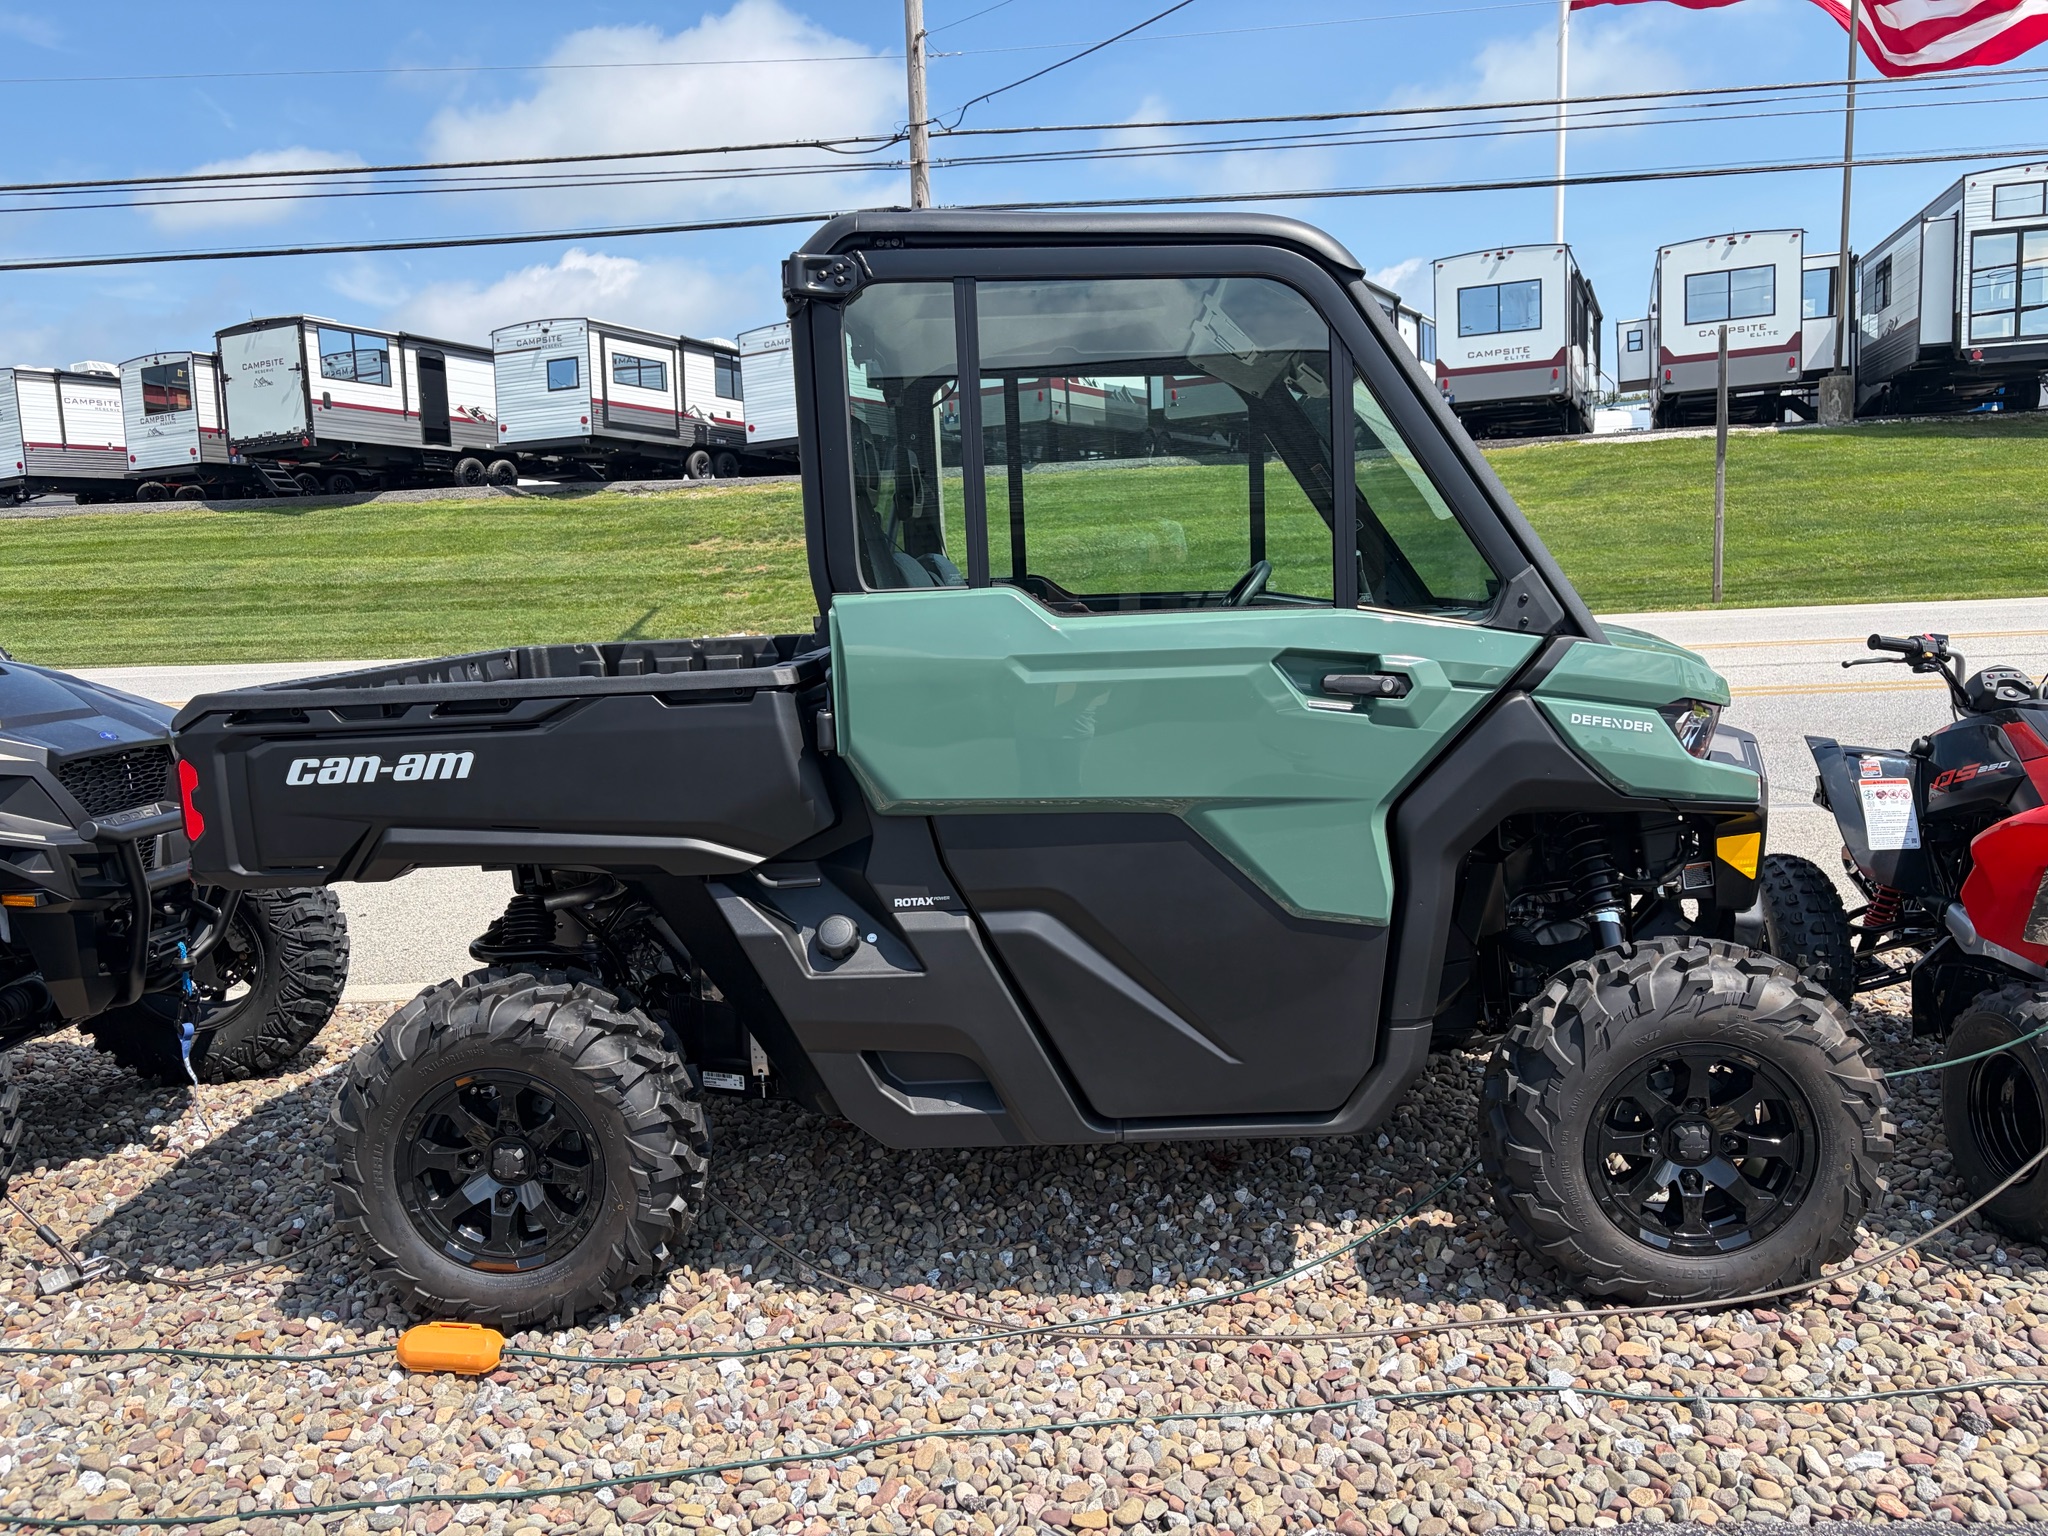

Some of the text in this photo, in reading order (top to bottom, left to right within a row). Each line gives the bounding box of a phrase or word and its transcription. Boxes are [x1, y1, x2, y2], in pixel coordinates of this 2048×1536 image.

[1750, 330, 1779, 338] ELITE
[516, 334, 562, 347] CAMPSITE
[1467, 346, 1530, 359] CAMPSITE
[241, 357, 285, 371] CAMPSITE
[63, 397, 120, 408] CAMPSITE
[140, 413, 176, 425] CAMPSITE
[1570, 713, 1654, 733] DEFENDER
[285, 751, 475, 786] can-am
[1978, 761, 2010, 773] 250
[894, 897, 934, 907] ROTAX
